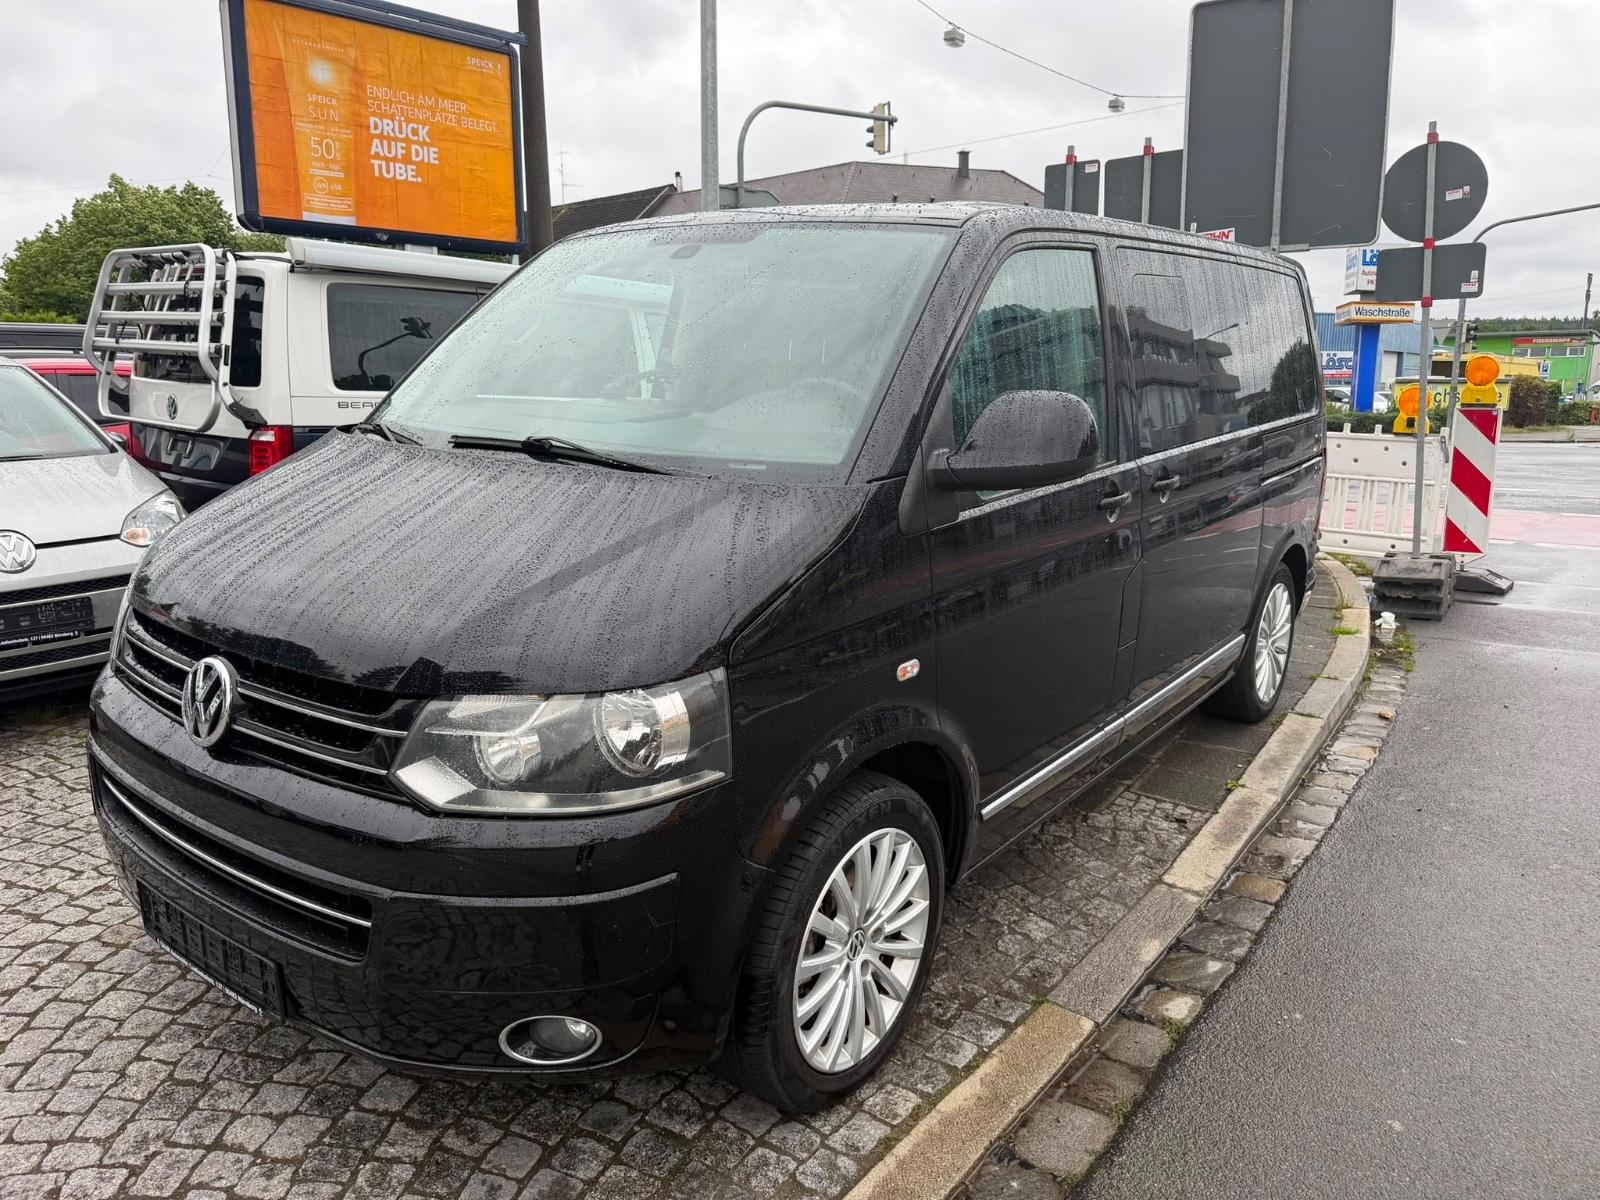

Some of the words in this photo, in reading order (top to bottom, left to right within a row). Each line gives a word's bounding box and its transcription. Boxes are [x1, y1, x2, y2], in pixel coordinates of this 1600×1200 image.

[307, 93, 338, 106] SPEICK
[367, 84, 415, 104] ENDLICH
[418, 94, 435, 107] AM
[369, 115, 431, 143] DRÜCK
[461, 116, 500, 134] BELEGT.
[370, 138, 406, 159] AUF
[411, 144, 439, 165] DIE
[370, 158, 422, 183] TUBE.
[1354, 306, 1411, 318] Waschstraße
